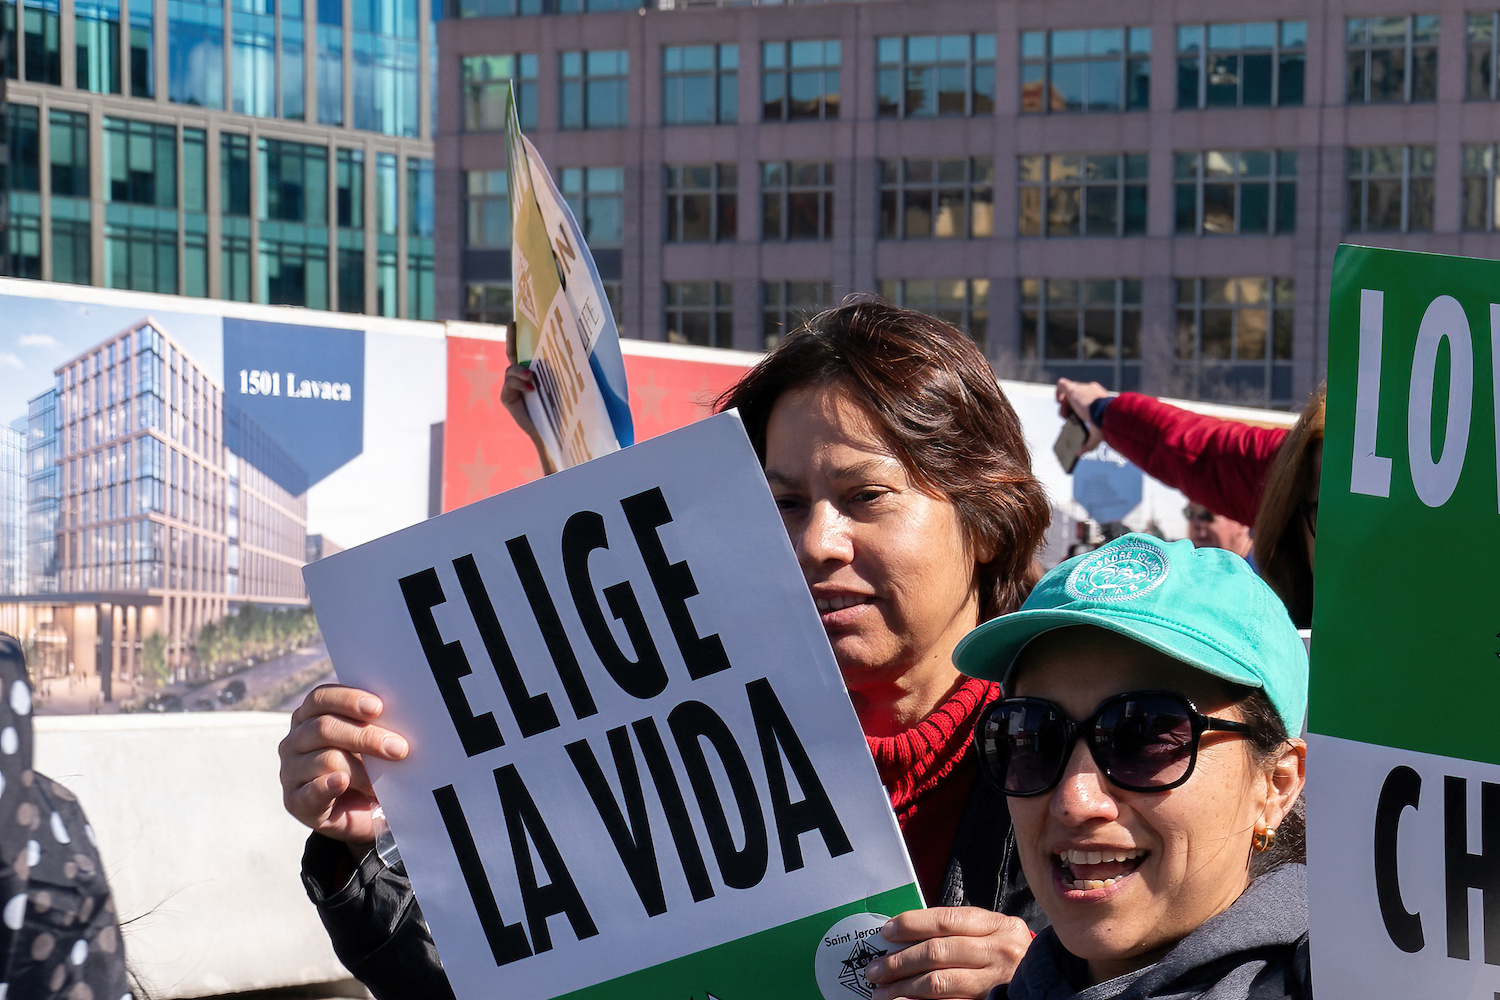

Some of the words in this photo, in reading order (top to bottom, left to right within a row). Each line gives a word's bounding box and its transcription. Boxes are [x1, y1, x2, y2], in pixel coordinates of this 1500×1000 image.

[240, 369, 280, 397] 1501
[286, 372, 351, 401] Lavaca
[398, 486, 731, 756] ELIGE
[432, 763, 599, 967] LA
[564, 677, 854, 918] VIDA
[825, 932, 851, 947] Saint
